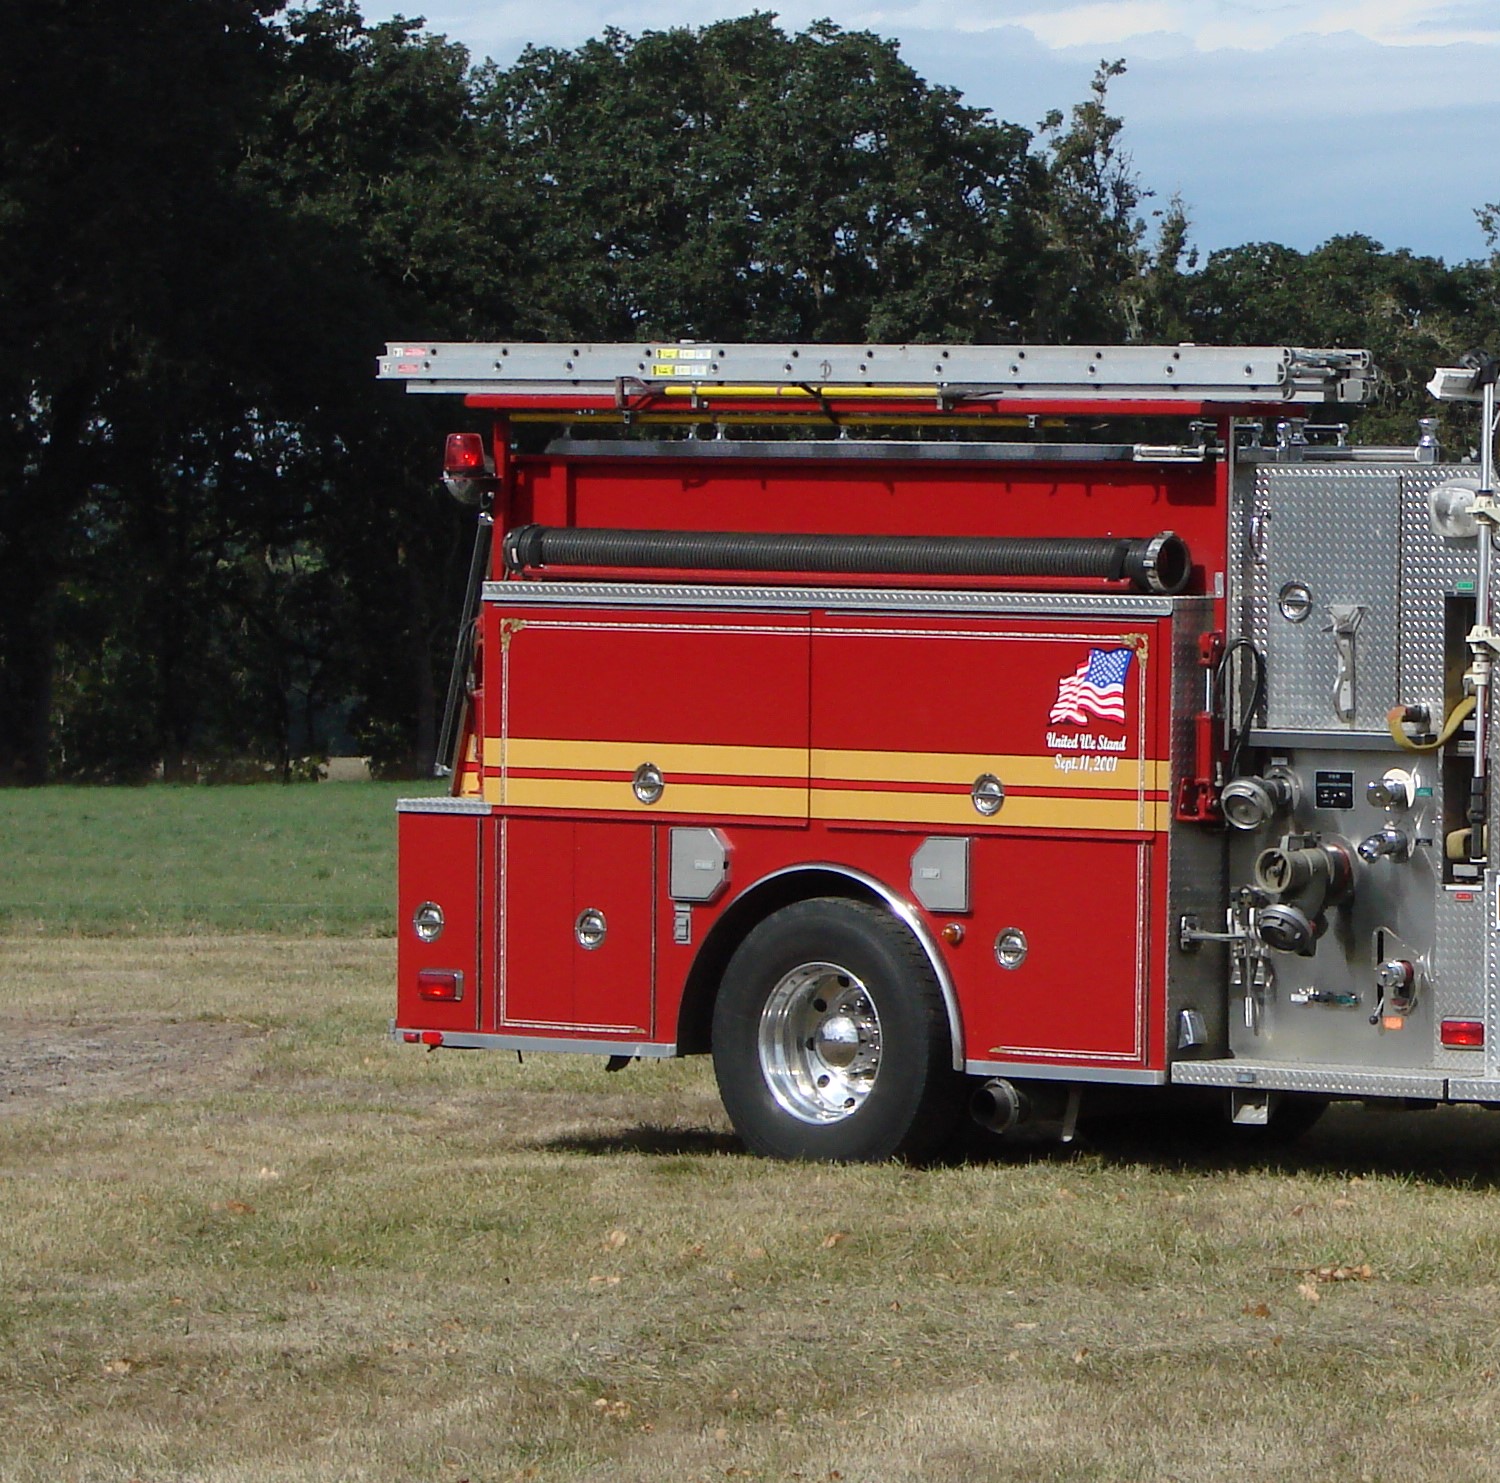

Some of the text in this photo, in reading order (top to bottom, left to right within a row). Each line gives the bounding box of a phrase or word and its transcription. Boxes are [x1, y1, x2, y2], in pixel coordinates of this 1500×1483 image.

[1046, 732, 1126, 751] United We Stand
[1055, 753, 1078, 774] Sept.
[1094, 755, 1118, 771] 2001
